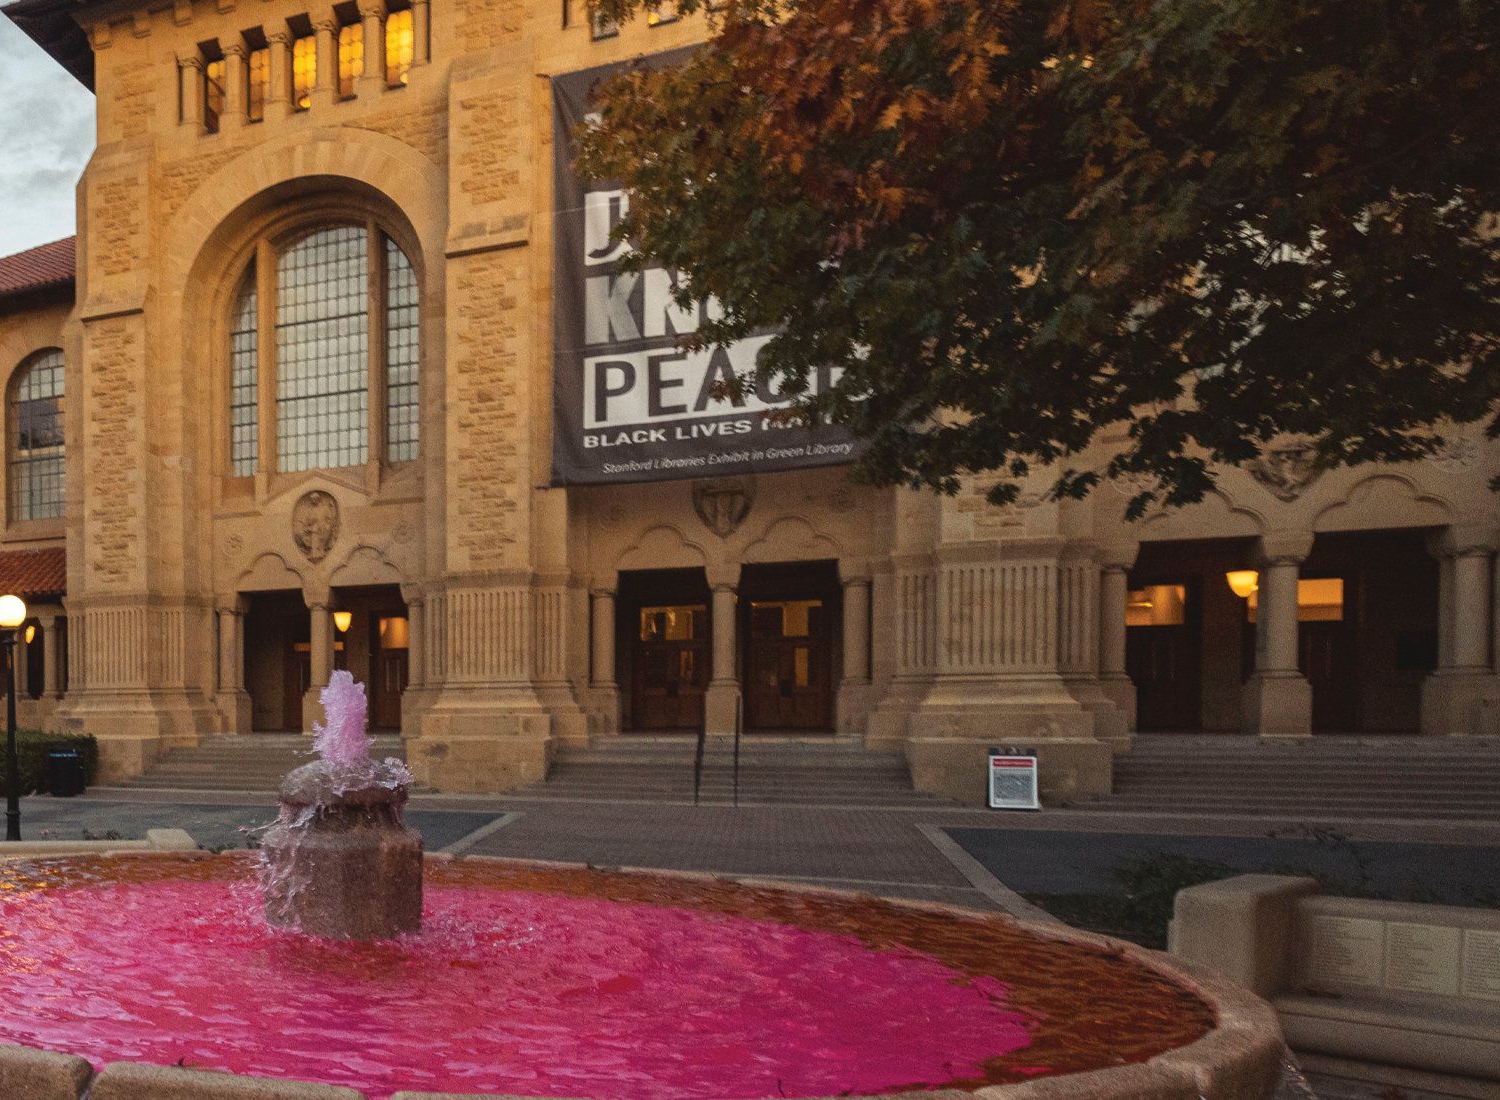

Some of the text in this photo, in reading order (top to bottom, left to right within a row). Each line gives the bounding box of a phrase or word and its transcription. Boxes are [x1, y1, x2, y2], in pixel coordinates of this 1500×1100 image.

[583, 428, 667, 448] BLACK
[675, 419, 752, 440] LIVES
[603, 441, 853, 474] Stanford Libraries Exhibit in Green Library
